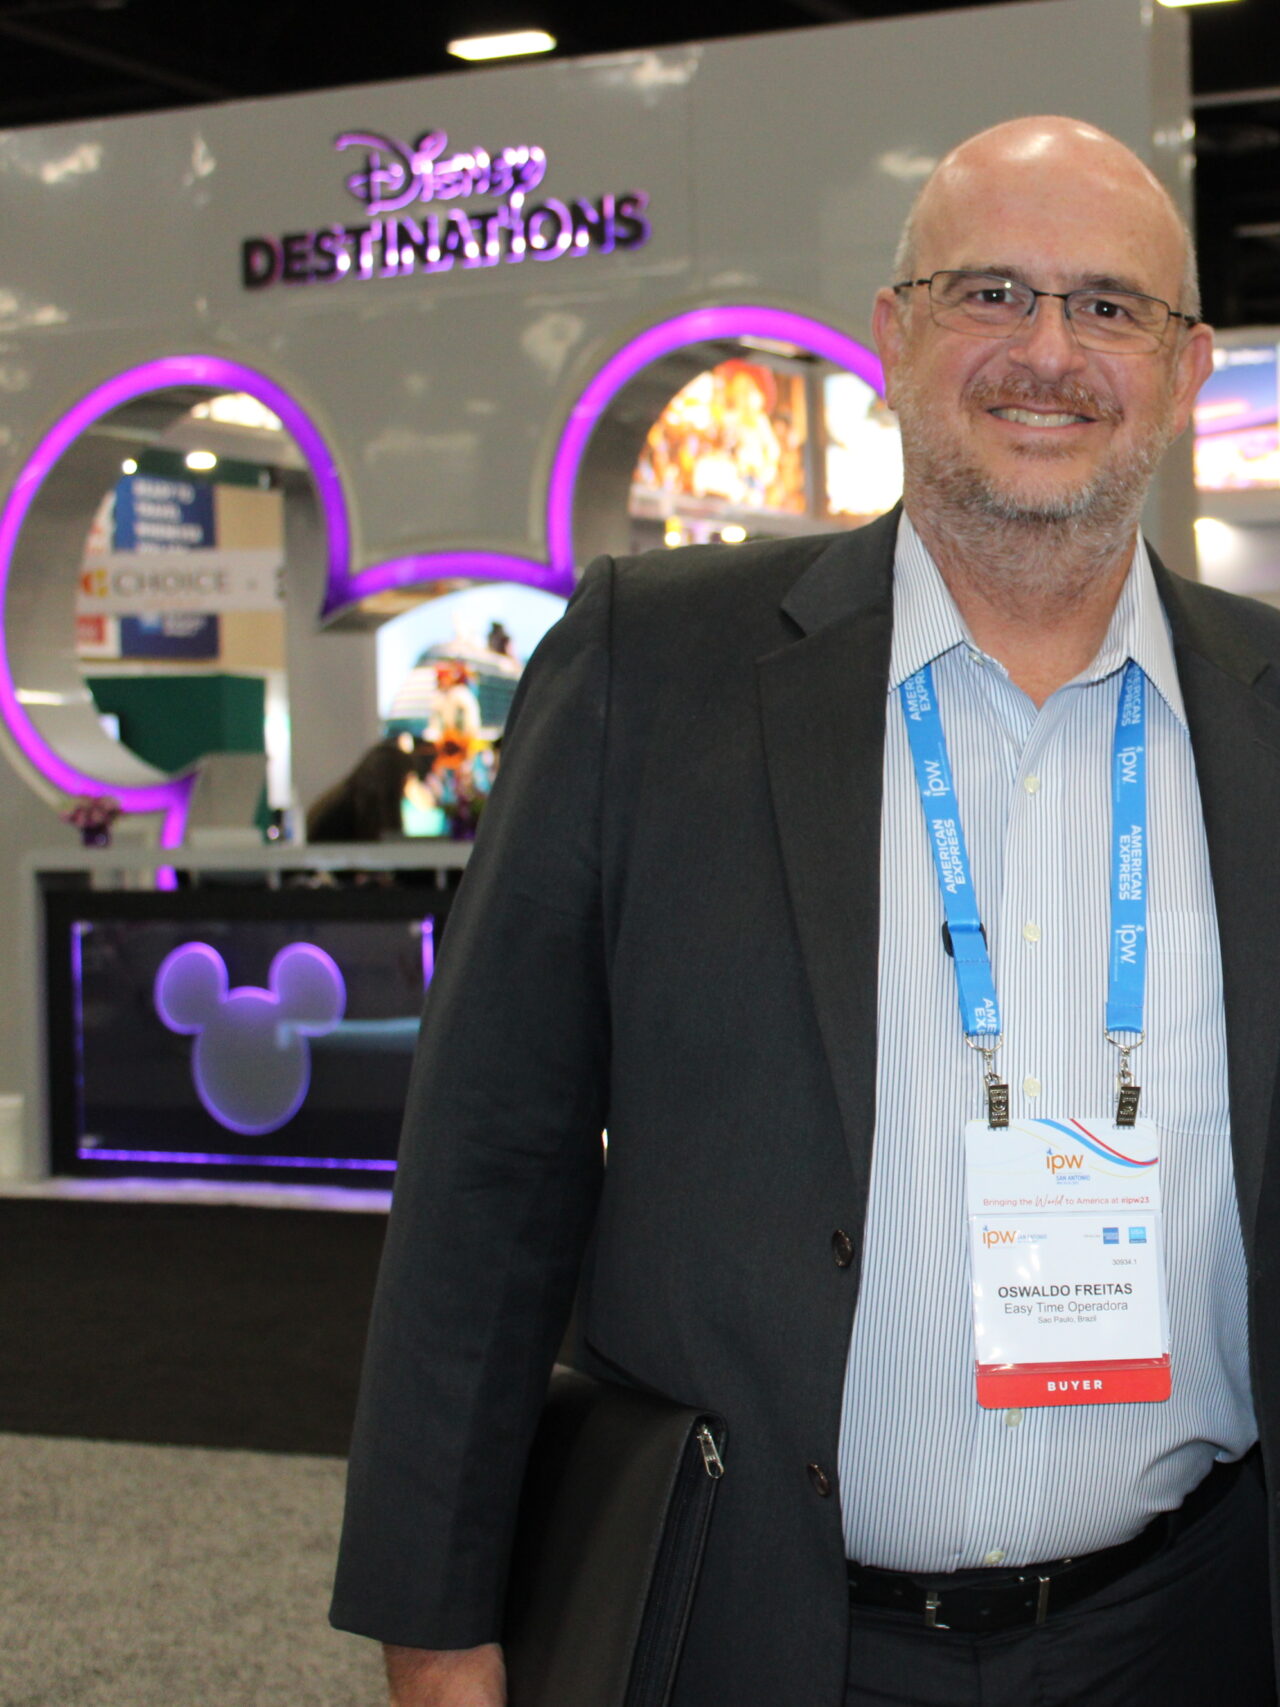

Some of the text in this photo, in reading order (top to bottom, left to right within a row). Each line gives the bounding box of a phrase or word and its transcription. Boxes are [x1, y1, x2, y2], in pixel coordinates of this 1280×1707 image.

[333, 128, 547, 218] Disney
[242, 188, 652, 290] DESTINATIONS
[113, 568, 227, 597] CHOICE
[923, 760, 950, 797] ipw
[1117, 746, 1144, 784] ipw
[932, 819, 958, 894] AMERICAN
[943, 818, 966, 886] EXPRESS
[1118, 834, 1131, 901] EXPRESS
[1130, 824, 1143, 901] AMERICAN
[1115, 924, 1144, 965] ipw
[1046, 1149, 1084, 1175] ipw
[983, 1198, 1018, 1208] Bringing
[1019, 1198, 1033, 1206] the
[1035, 1194, 1064, 1208] World
[1065, 1197, 1073, 1205] to
[1076, 1197, 1109, 1205] America
[982, 1226, 1016, 1249] ipw
[998, 1283, 1133, 1298] OSWALDO FREITAS
[1004, 1300, 1129, 1316] Easy Time Operadora
[1054, 1316, 1077, 1324] Paulo,
[1078, 1315, 1097, 1323] Brazil
[1047, 1380, 1103, 1392] BUYER
